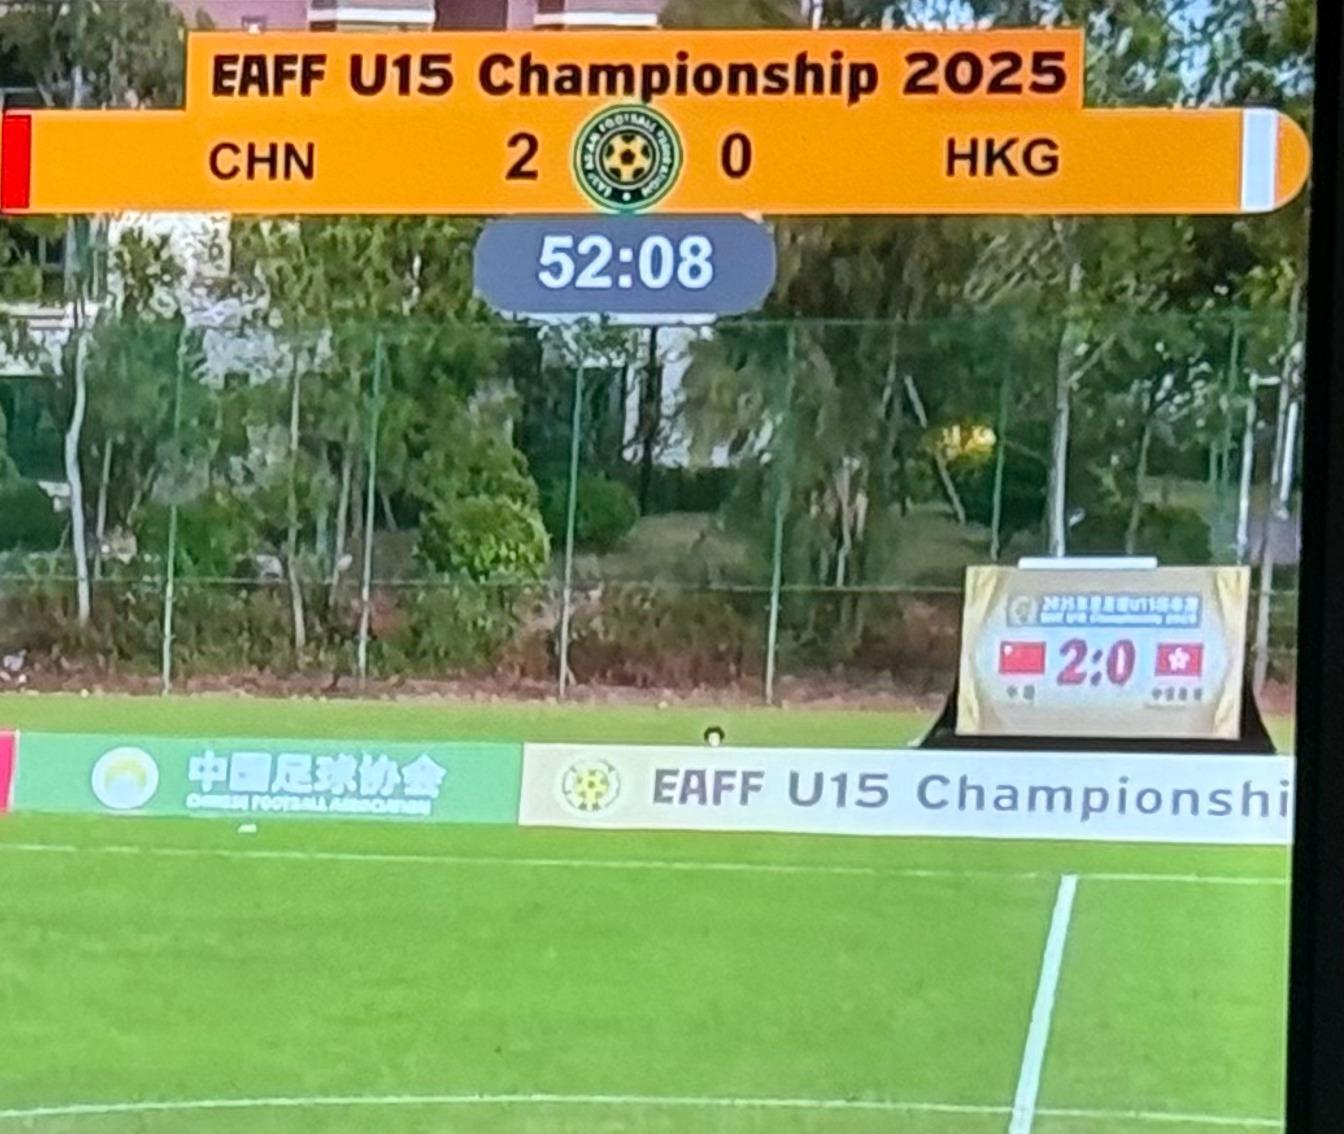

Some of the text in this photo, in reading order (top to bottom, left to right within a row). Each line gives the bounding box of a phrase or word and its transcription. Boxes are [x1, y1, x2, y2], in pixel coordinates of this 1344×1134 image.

[212, 50, 1067, 107] EAFF U15 Championship 2025
[209, 141, 314, 182] CHN
[505, 132, 539, 181] 2
[720, 131, 752, 180] 0
[945, 136, 1060, 178] HKG
[537, 233, 714, 290] 52:08
[1055, 637, 1137, 687] 2:0
[652, 767, 766, 807] EAFF
[787, 769, 890, 809] U15
